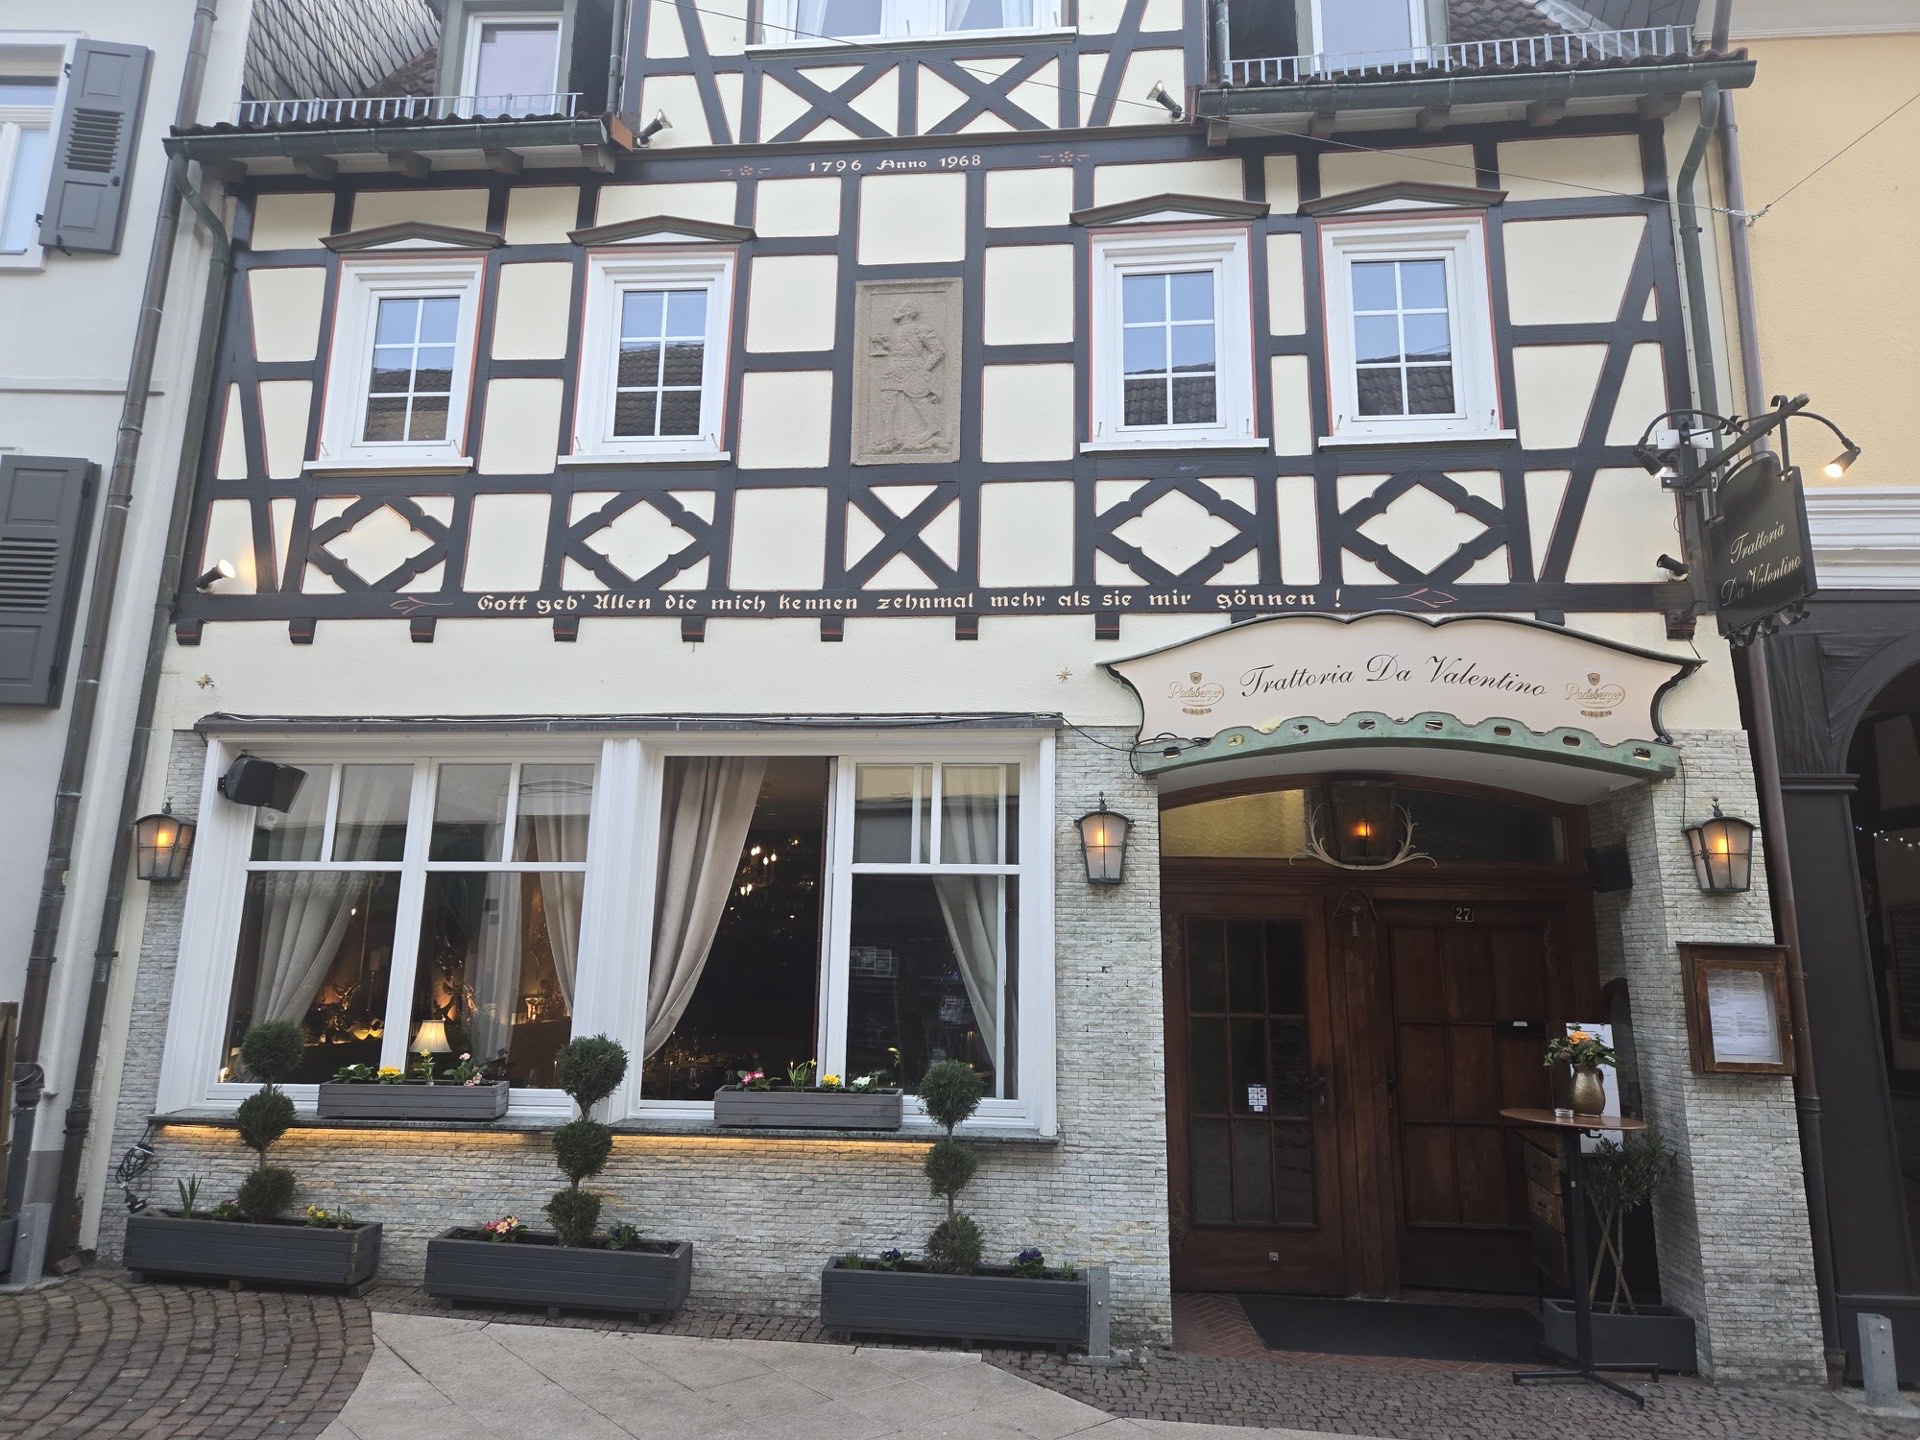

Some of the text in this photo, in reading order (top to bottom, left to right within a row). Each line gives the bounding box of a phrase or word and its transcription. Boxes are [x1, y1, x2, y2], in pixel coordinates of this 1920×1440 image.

[808, 154, 981, 172] 1796 Anno 1968
[1730, 521, 1786, 564] Trattoria
[1720, 555, 1801, 607] Da Valentino
[477, 595, 528, 610] Gott
[536, 594, 586, 614] geb'
[665, 594, 698, 610] die
[711, 595, 766, 612] mich
[779, 594, 858, 610] kennen
[876, 592, 974, 611] zehnmal
[990, 591, 1046, 609] mehr
[1057, 591, 1091, 607] als
[1101, 591, 1132, 607] sie
[1148, 591, 1191, 607] mir
[1216, 590, 1316, 610] gönnen
[1240, 653, 1547, 697] Trattoria Da Valentino
[1455, 906, 1471, 920] 27
